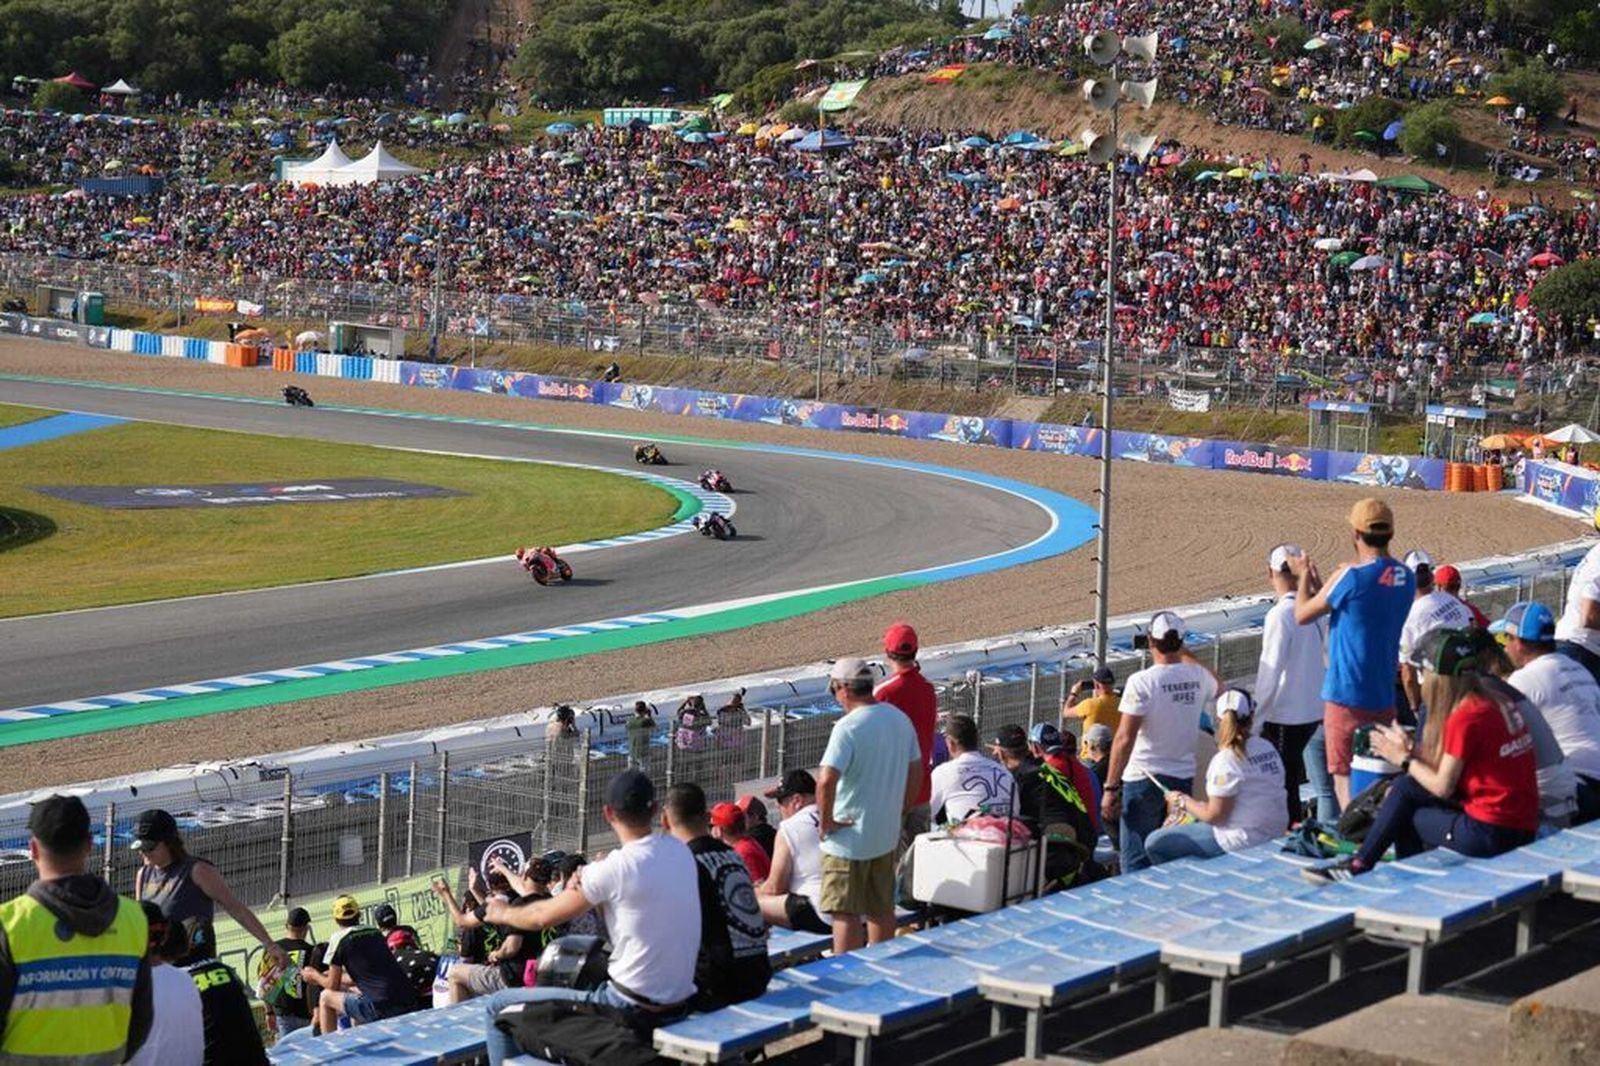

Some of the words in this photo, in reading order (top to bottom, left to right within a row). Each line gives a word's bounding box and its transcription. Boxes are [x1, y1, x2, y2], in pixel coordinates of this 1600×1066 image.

[1377, 565, 1407, 587] 42
[90, 966, 100, 979] Y
[193, 967, 232, 990] 46
